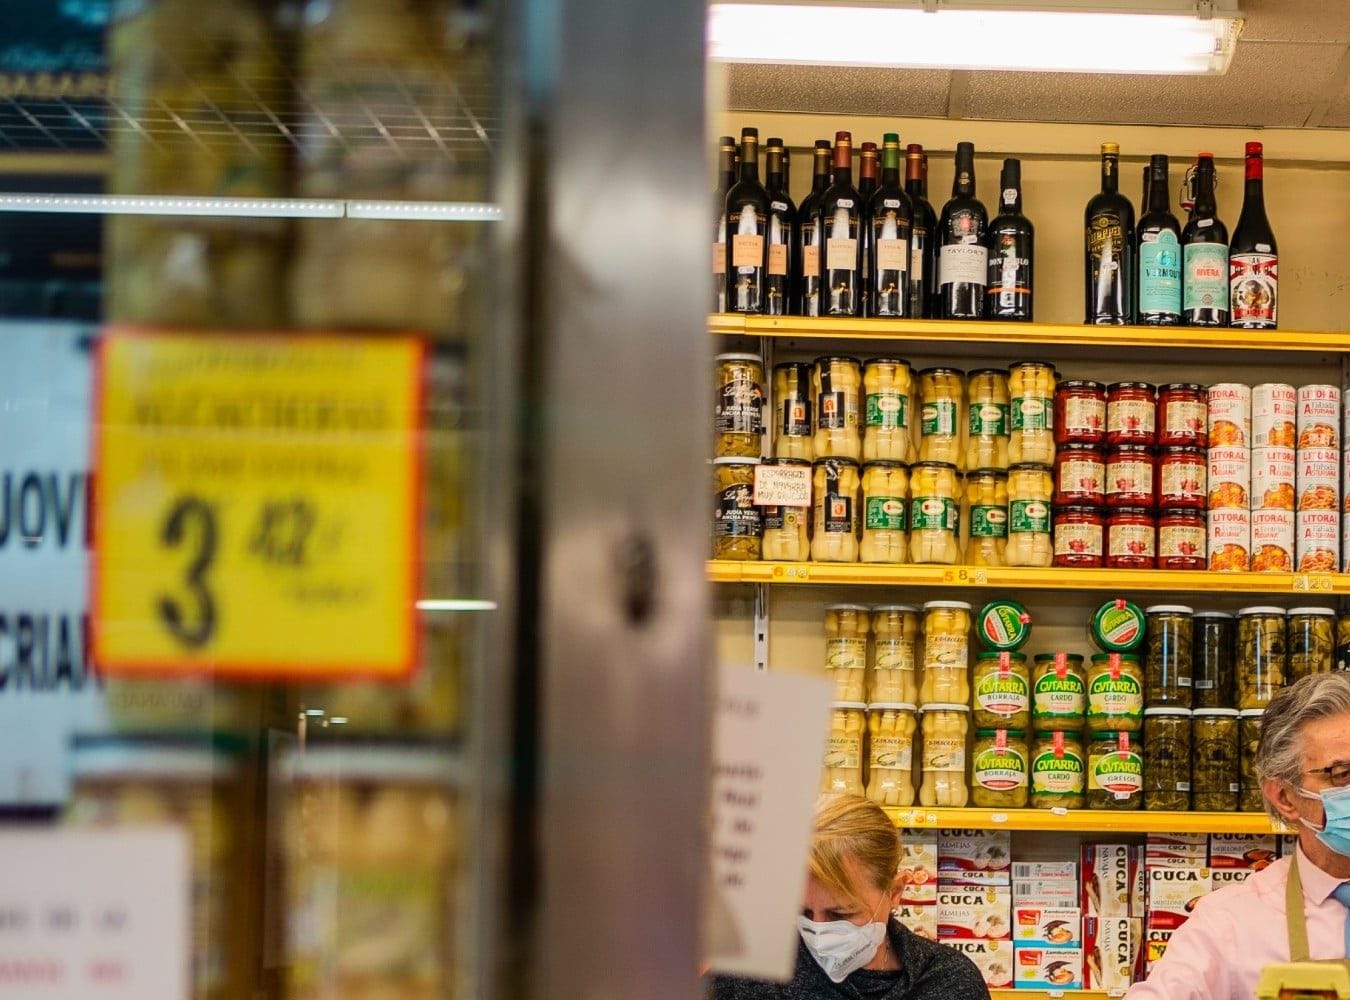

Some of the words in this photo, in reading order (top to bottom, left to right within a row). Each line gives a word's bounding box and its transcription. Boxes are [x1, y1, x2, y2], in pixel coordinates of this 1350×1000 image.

[1210, 451, 1246, 461] LITORAL
[1212, 514, 1248, 523] LITORAL
[1050, 693, 1074, 702] CARDO
[1047, 772, 1071, 781] CARDO
[1115, 847, 1126, 891] CUCA
[961, 871, 985, 879] CUCA
[1152, 871, 1198, 881] CUCA
[962, 885, 986, 893] CUCA
[940, 895, 984, 905] CUCA
[1118, 920, 1128, 964] CUCA
